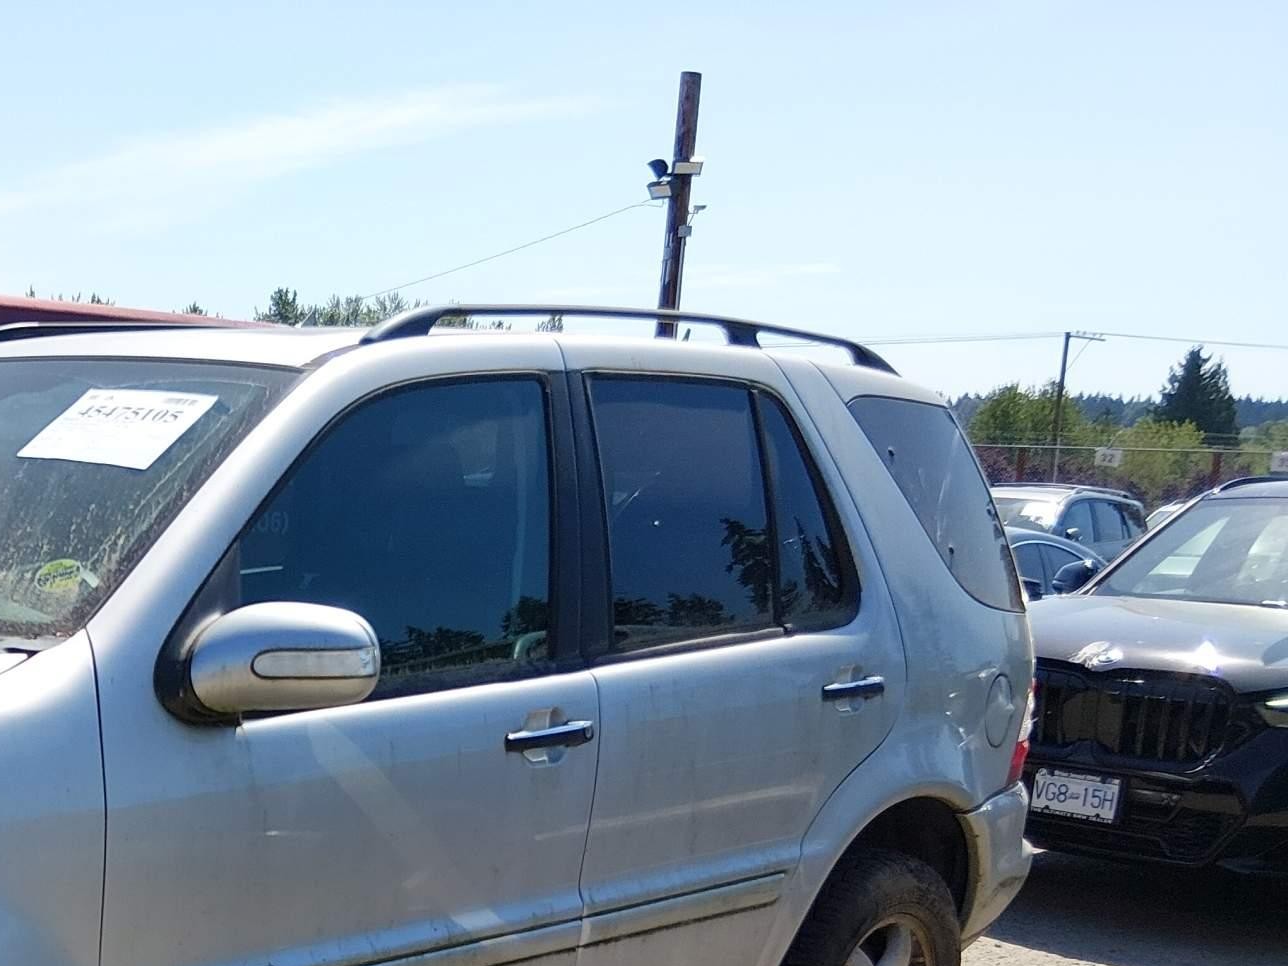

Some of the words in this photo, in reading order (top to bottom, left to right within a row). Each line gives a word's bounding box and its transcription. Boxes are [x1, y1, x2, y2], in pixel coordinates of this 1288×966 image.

[78, 404, 185, 424] 45475105
[1035, 780, 1069, 803] VG8
[1081, 786, 1116, 812] 15H
